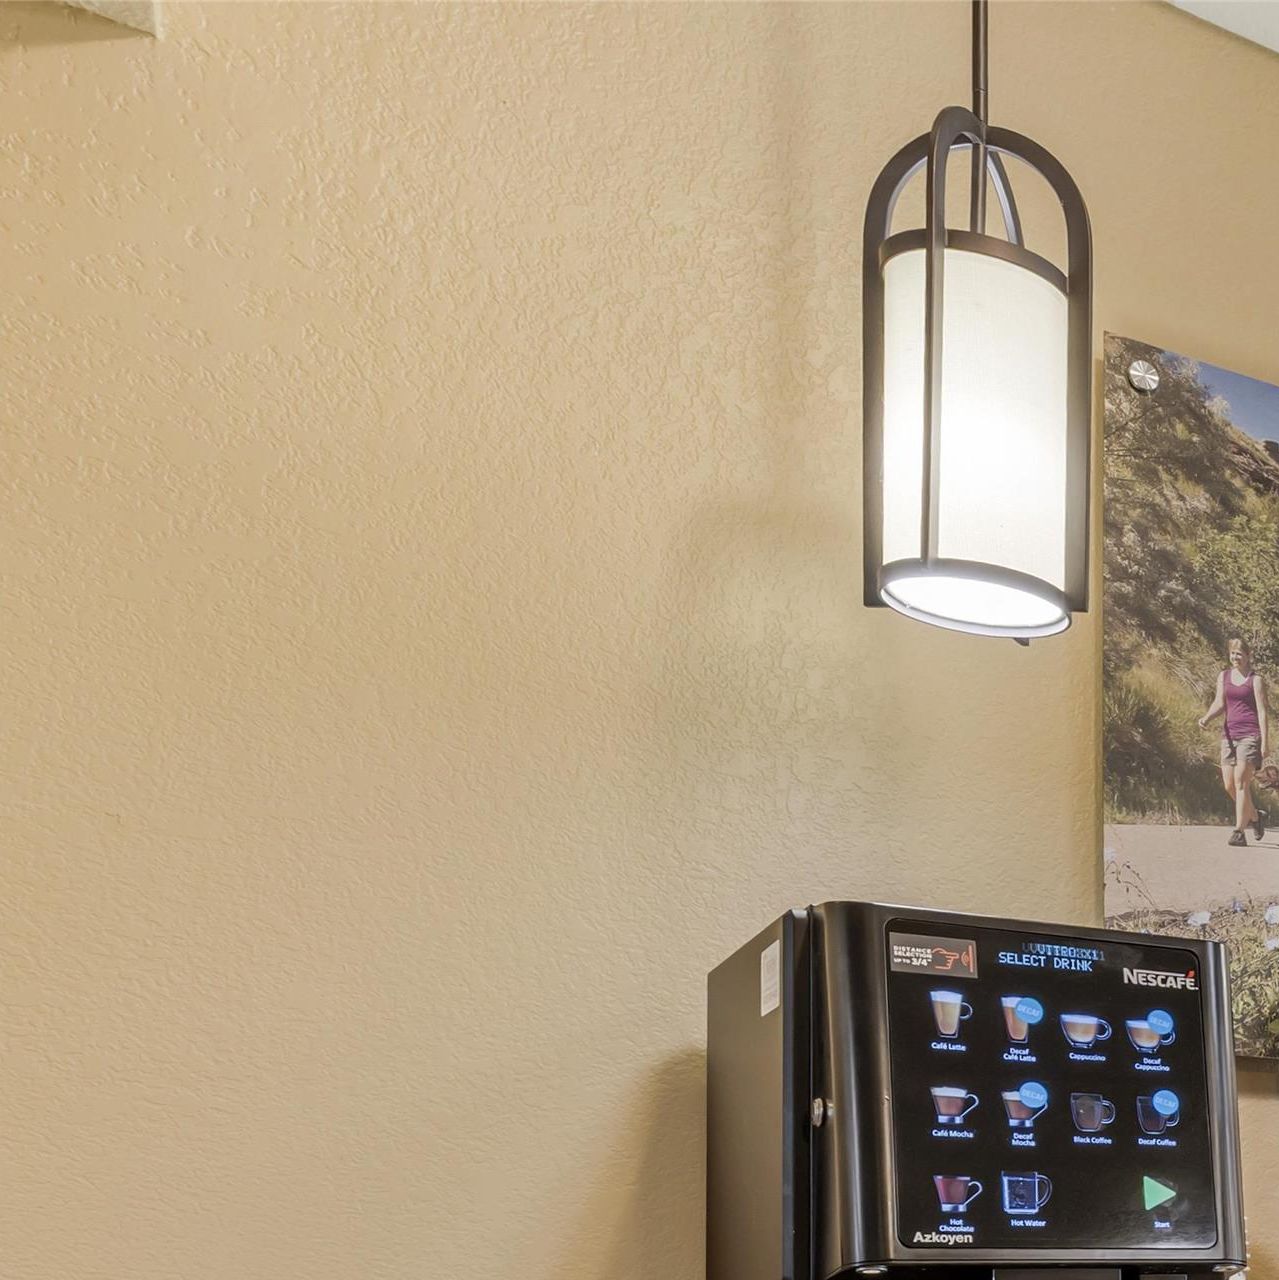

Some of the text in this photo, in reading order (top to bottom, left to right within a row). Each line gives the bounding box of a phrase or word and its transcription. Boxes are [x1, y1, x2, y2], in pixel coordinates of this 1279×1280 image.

[893, 945, 931, 953] DISTANCE
[893, 951, 932, 959] SELECTION
[998, 952, 1093, 972] SELECT DRINK
[931, 1041, 966, 1051] Café Latte
[1010, 1047, 1029, 1055] Decaf
[1003, 1053, 1036, 1062] Café Latte
[1069, 1052, 1106, 1062] Cappuccino
[1143, 1057, 1162, 1065] Decaf
[1134, 1063, 1171, 1073] Cappuccino
[932, 1129, 974, 1138] Café Mocha
[1013, 1132, 1034, 1140] Decaf
[1012, 1139, 1036, 1147] Mocha
[1073, 1135, 1113, 1145] Black Coffee
[1138, 1138, 1177, 1147] Decaf Coffee
[950, 1218, 963, 1226] Hot
[1010, 1219, 1047, 1228] Hot Water
[939, 1225, 975, 1233] Chocolate
[913, 1231, 974, 1246] Azkoyen
